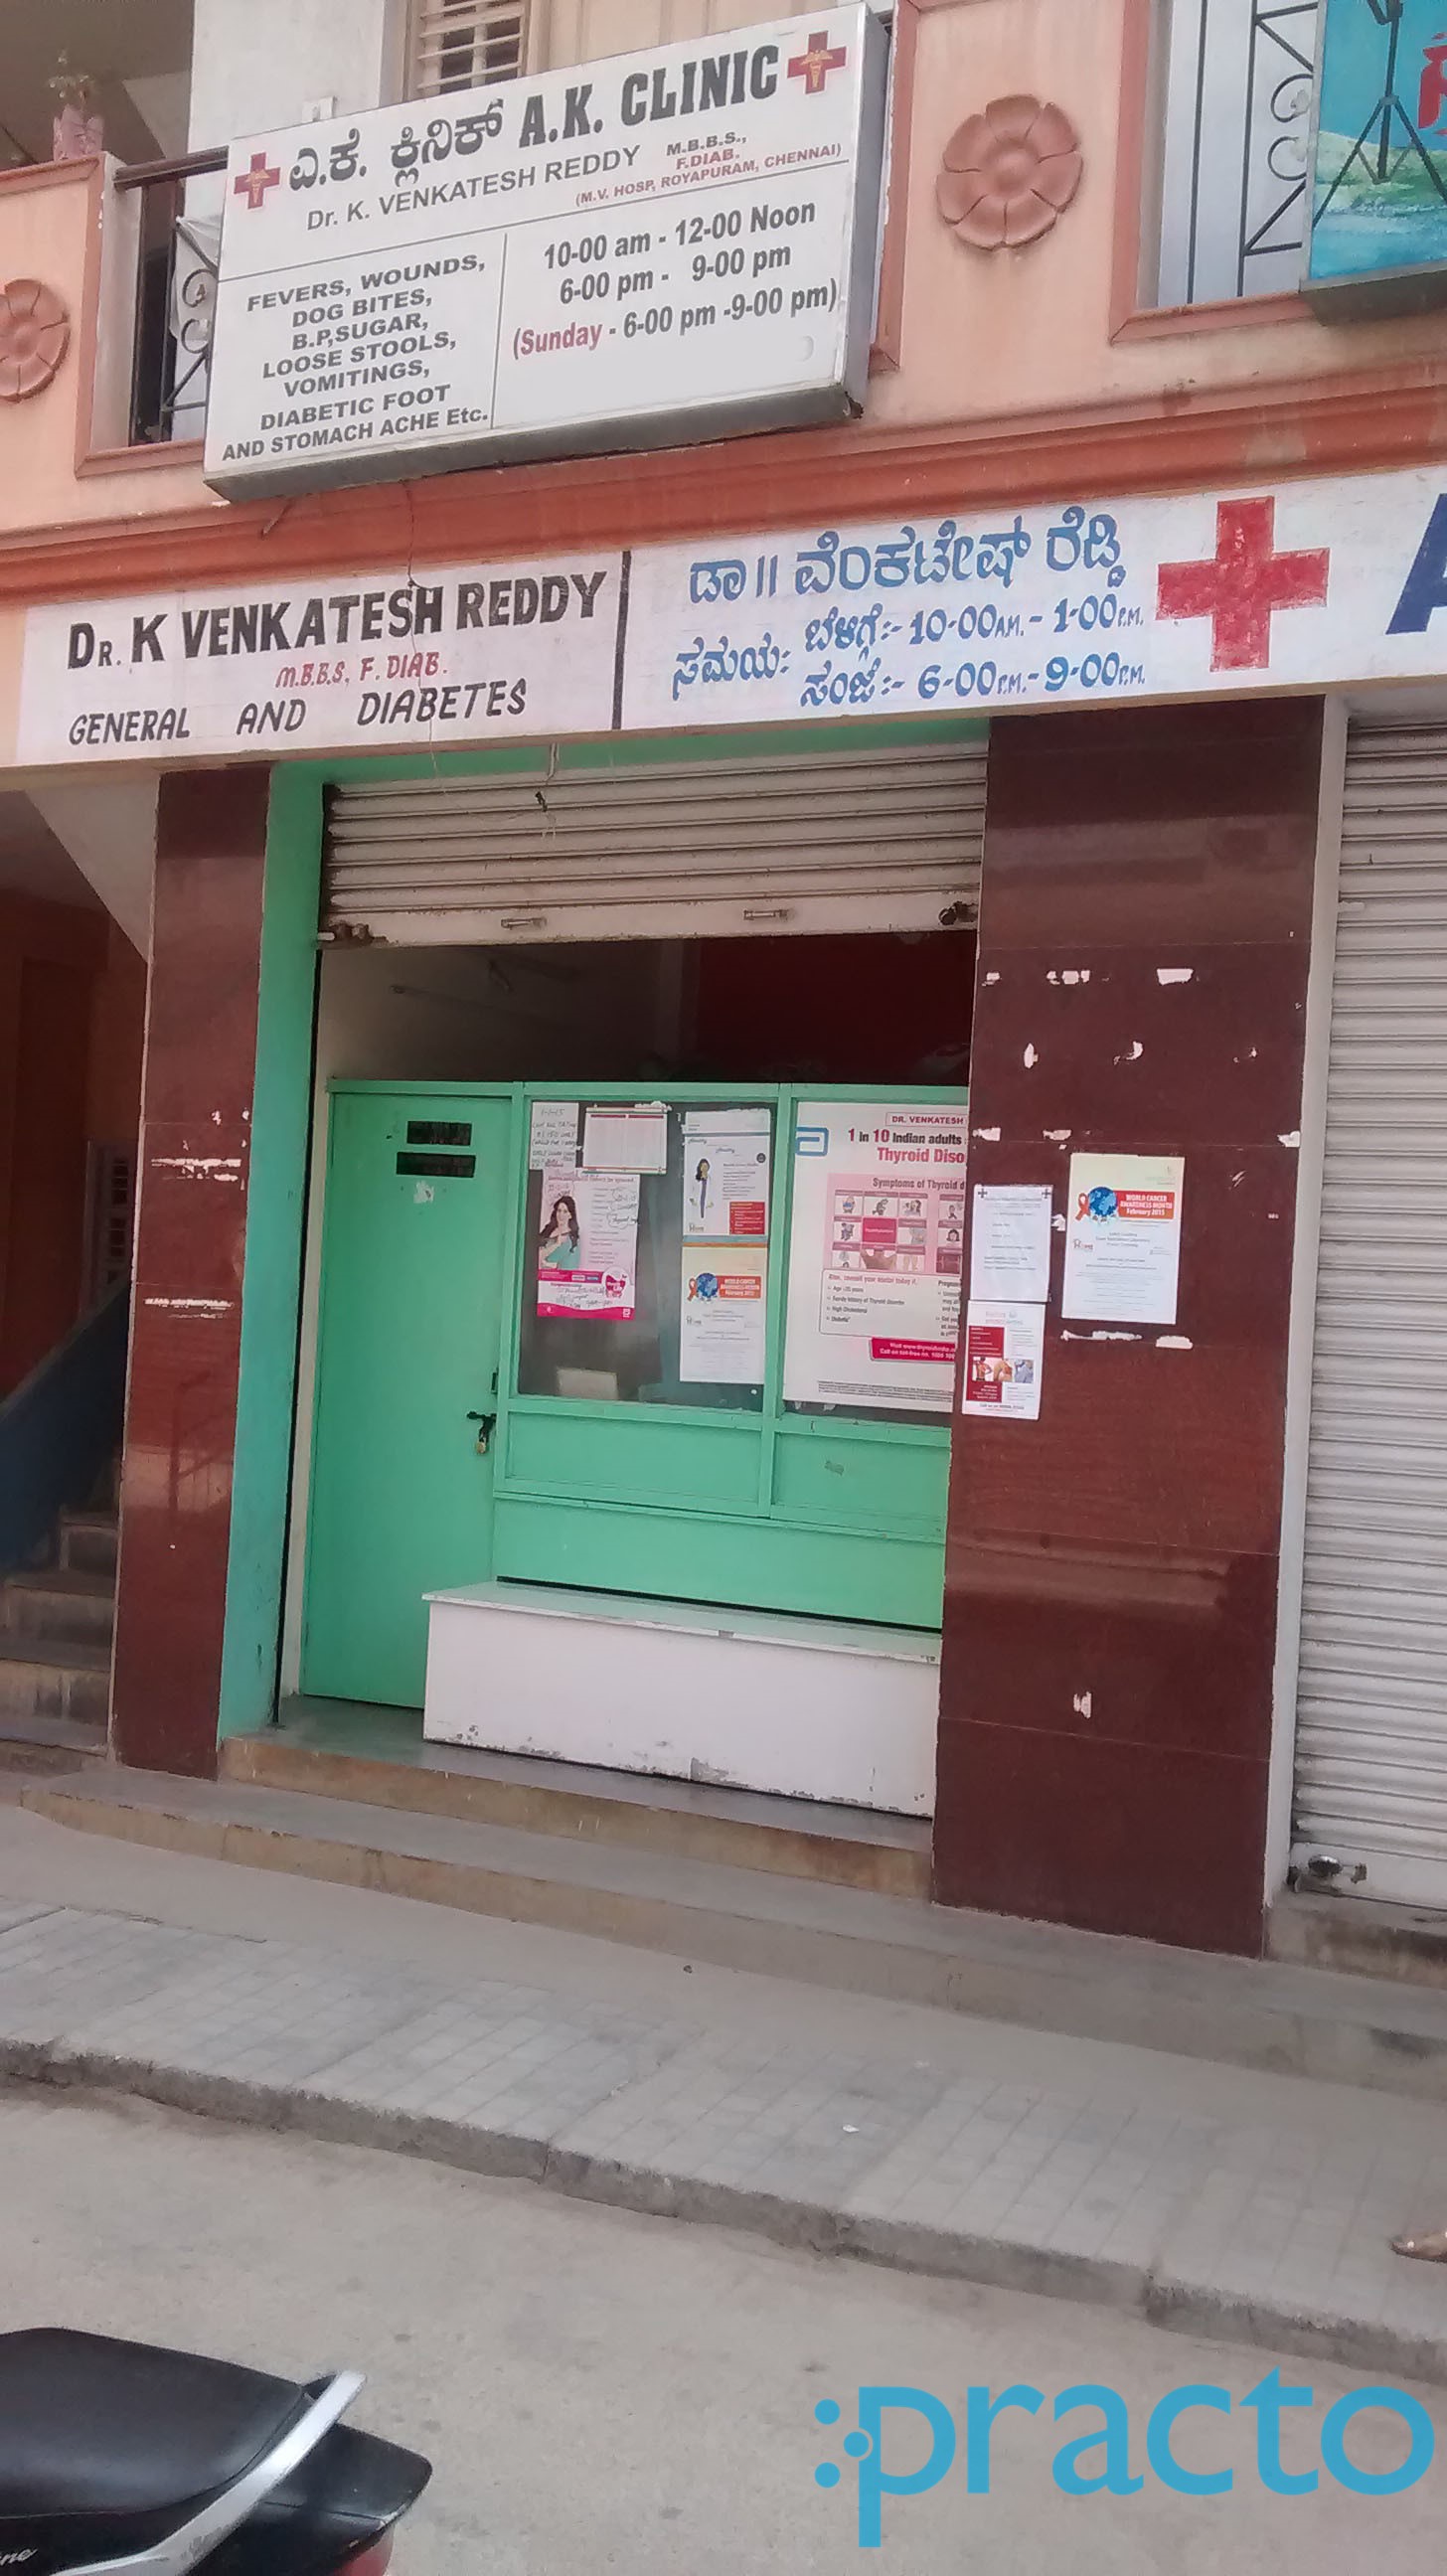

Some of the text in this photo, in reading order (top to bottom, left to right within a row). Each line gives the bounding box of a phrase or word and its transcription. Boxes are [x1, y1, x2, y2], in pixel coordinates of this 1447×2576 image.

[519, 45, 779, 148] A.K. CLINIC
[391, 98, 504, 188] ಕ್ಲಿನಿಕ್
[667, 131, 747, 157] M.B.B.S.,
[676, 148, 740, 170] F.DIAB.
[307, 145, 641, 231] Dr. K. VENKATESH REDDY
[575, 188, 609, 208] (M.V.
[660, 160, 759, 189] ROYAPURAM,
[763, 143, 842, 168] CHENNAI)
[544, 235, 607, 269] 10-00
[614, 232, 651, 257] am
[675, 210, 742, 245] 12-00
[749, 202, 816, 233] Noon
[246, 254, 485, 312] FEVERS, WOUNDS,
[561, 271, 609, 304] 6-00
[617, 269, 654, 300] pm
[692, 247, 745, 282] 9-00
[752, 245, 791, 277] pm
[292, 288, 432, 328] DOG BITES,
[513, 322, 602, 360] (Sunday
[623, 305, 673, 339] 6-00
[681, 304, 716, 336] pm
[791, 278, 838, 318] pm)
[262, 330, 456, 379] LOOSE STOOLS,
[283, 359, 430, 398] VOMITINGS,
[222, 407, 488, 461] AND STOMACH ACHE Etc.
[260, 384, 451, 430] DIABETIC FOOT
[1045, 505, 1127, 588] ರೆಡ್ಡಿ
[130, 613, 168, 664] K
[182, 585, 443, 660] VENKATESH
[456, 570, 607, 630] REDDY
[387, 651, 447, 679] DIAB.
[69, 678, 527, 746] GENERAL AND DIABETES
[848, 1128, 855, 1142] 1
[873, 1128, 890, 1143] 10
[892, 1133, 926, 1145] Indian
[928, 1133, 962, 1146] adults
[909, 1116, 964, 1125] VENKATESH
[877, 1147, 930, 1165] Thyroid
[873, 1178, 914, 1189] Symptoms
[916, 1178, 925, 1188] of
[926, 1179, 957, 1192] Thyroid
